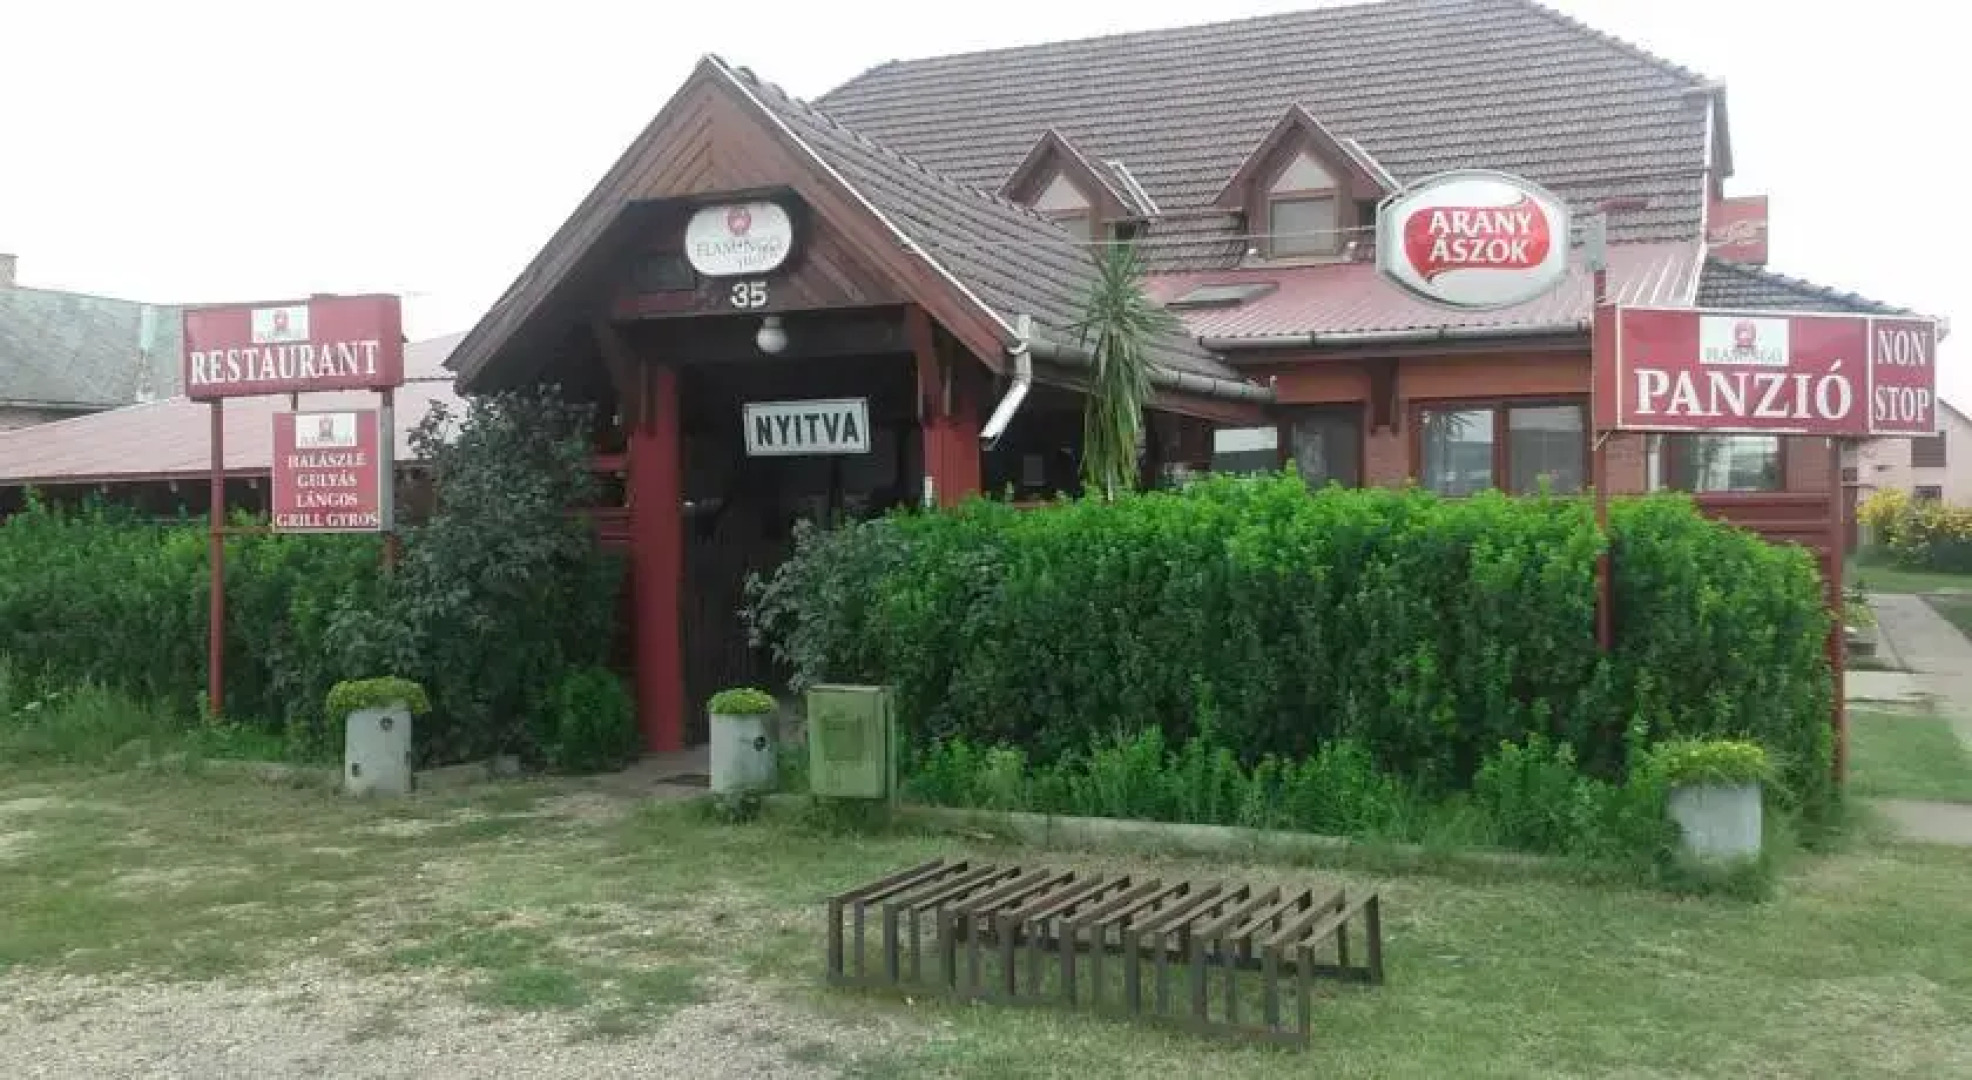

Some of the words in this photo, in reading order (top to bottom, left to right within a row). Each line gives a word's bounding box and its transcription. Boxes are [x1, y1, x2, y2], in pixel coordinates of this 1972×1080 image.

[1427, 210, 1532, 236] ARANY
[1428, 234, 1530, 263] ÁSZOK
[730, 281, 768, 308] 35
[189, 340, 379, 386] RESTAURANT
[1877, 329, 1928, 366] NON
[1633, 359, 1852, 420] PANZIÓ
[1875, 385, 1929, 422] STOP
[755, 412, 860, 447] NYITVA
[296, 490, 358, 508] LÁNGOS
[276, 513, 325, 527] GRILL
[326, 512, 378, 527] GYROS
